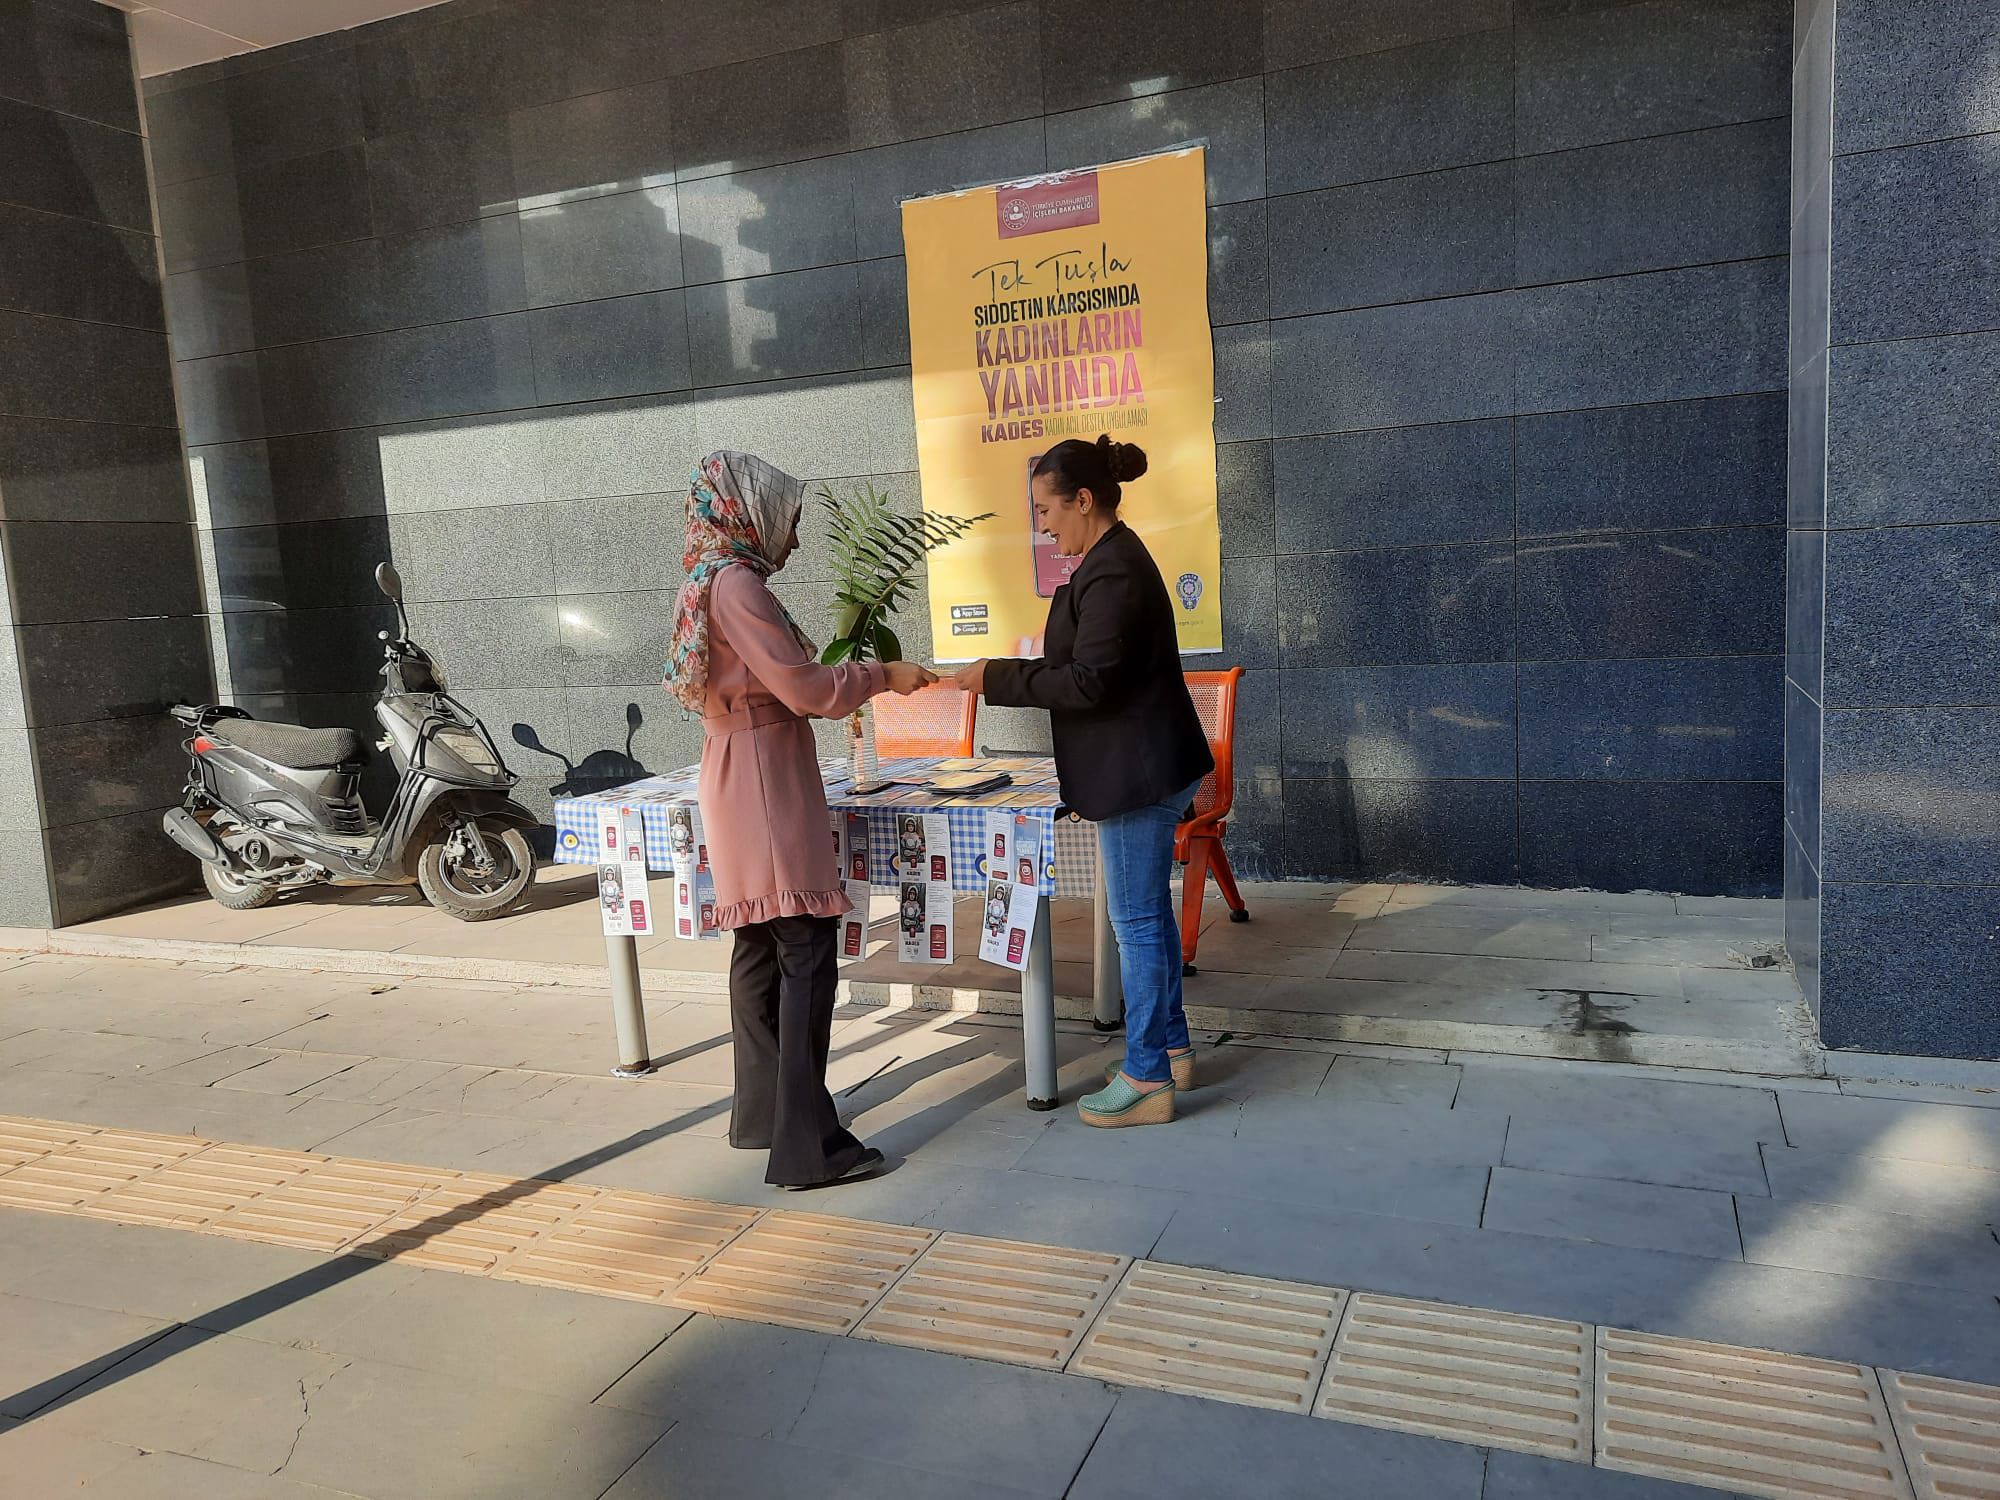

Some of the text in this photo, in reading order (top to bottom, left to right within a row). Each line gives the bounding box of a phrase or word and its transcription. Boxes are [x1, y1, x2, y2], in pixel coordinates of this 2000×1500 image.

[1059, 201, 1094, 214] BAKANLIĞI
[972, 241, 1132, 303] Tek Tuşla
[974, 282, 1141, 328] ŞİDDETİN KARŞISINDA
[975, 307, 1143, 368] KADINLARIN
[978, 351, 1145, 421] YANINDA
[981, 418, 1044, 443] KADES
[1045, 417, 1065, 437] KADIN
[1081, 412, 1106, 433] DESTEK
[1106, 407, 1149, 431] UYGULAMASI
[961, 610, 972, 618] App
